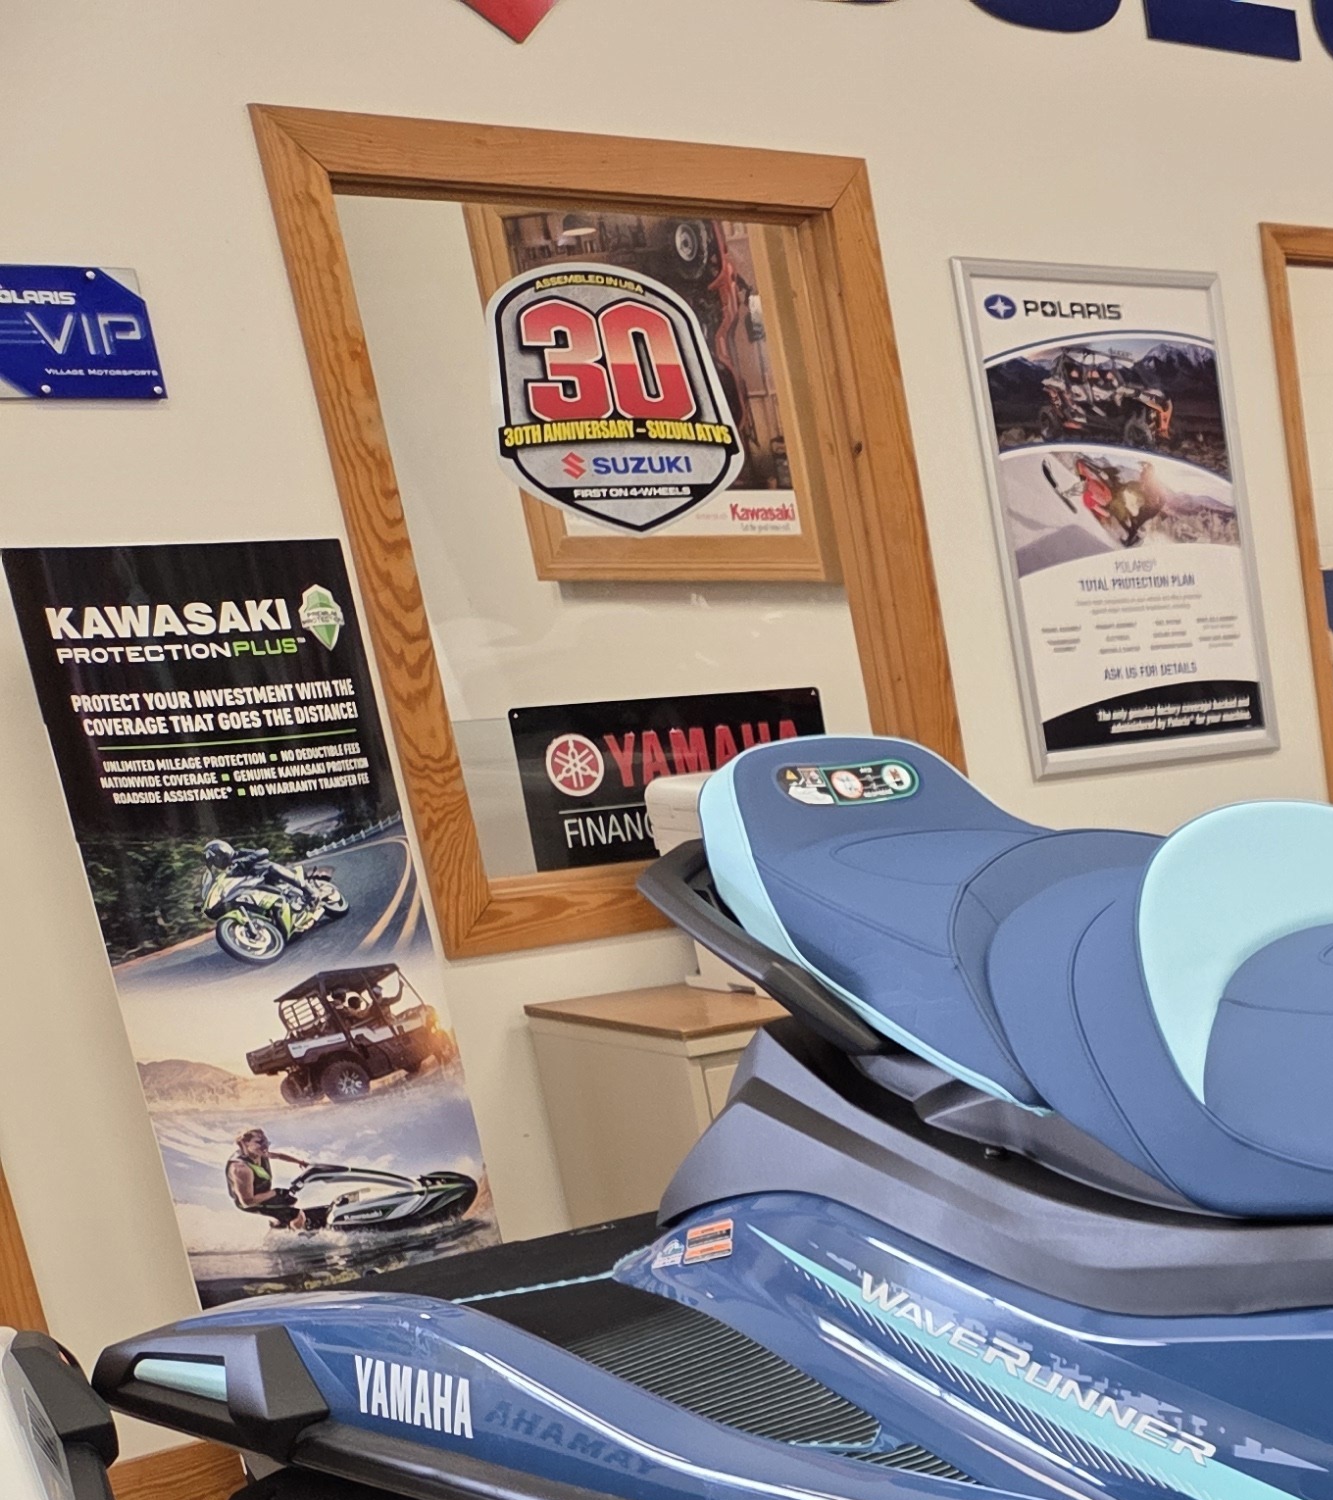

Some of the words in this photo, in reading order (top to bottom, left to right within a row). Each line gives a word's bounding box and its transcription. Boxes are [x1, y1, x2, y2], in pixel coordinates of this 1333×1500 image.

[0, 289, 76, 305] OLARIS
[534, 274, 604, 291] ASSEMBLED
[605, 275, 618, 287] IN
[618, 279, 645, 295] USA
[1023, 300, 1122, 320] POLARIS
[25, 311, 142, 355] VIP
[520, 299, 696, 420] 30
[503, 424, 542, 448] 30TH
[543, 419, 635, 445] ANNIVERSARY
[647, 420, 695, 440] SUZUKI
[694, 424, 732, 445] ATVS
[592, 455, 693, 475] SUZUKI
[574, 487, 608, 499] FIRST
[608, 487, 628, 498] ON
[629, 486, 692, 497] 4-WHEELS
[730, 503, 795, 521] Kawasaki
[1077, 577, 1109, 592] TOTAL
[1111, 574, 1170, 590] PROTECTION
[1171, 573, 1196, 587] PLAN
[45, 599, 292, 640] KAWASAKI
[1104, 668, 1124, 681] ASK
[1139, 665, 1158, 677] FOR
[1160, 662, 1197, 676] DETAILS
[70, 693, 141, 712] PROTECT
[142, 691, 191, 711] YOUR
[193, 683, 296, 709] INVESTMENT
[296, 680, 331, 700] WITH
[331, 678, 355, 697] THE
[83, 717, 169, 737] COVERAGE
[169, 714, 214, 733] THAT
[217, 711, 262, 731] GOES
[262, 707, 294, 727] THE
[295, 701, 358, 723] DISTANCE!
[103, 759, 155, 773] UNLIMITED
[156, 756, 202, 771] MILEAGE
[203, 752, 267, 769] PROTECTION
[280, 748, 295, 762] NO
[296, 744, 342, 761] DEDUCTIBLE
[342, 742, 360, 755] FEES
[604, 720, 799, 788] YAMA
[100, 776, 162, 789] NATIONWIDE
[163, 772, 217, 787] COVERAGE
[233, 768, 277, 782] GENUINE
[278, 762, 326, 780] KAWASAKI
[326, 757, 369, 774] PROTECTION
[113, 791, 162, 805] ROADSIDE
[249, 783, 265, 797] NO
[266, 780, 318, 795] WARRANTY
[318, 777, 355, 791] TRANSFER
[355, 772, 370, 786] FEE
[860, 1270, 1217, 1466] WAVERUNNER
[354, 1354, 474, 1439] YAMAHA
